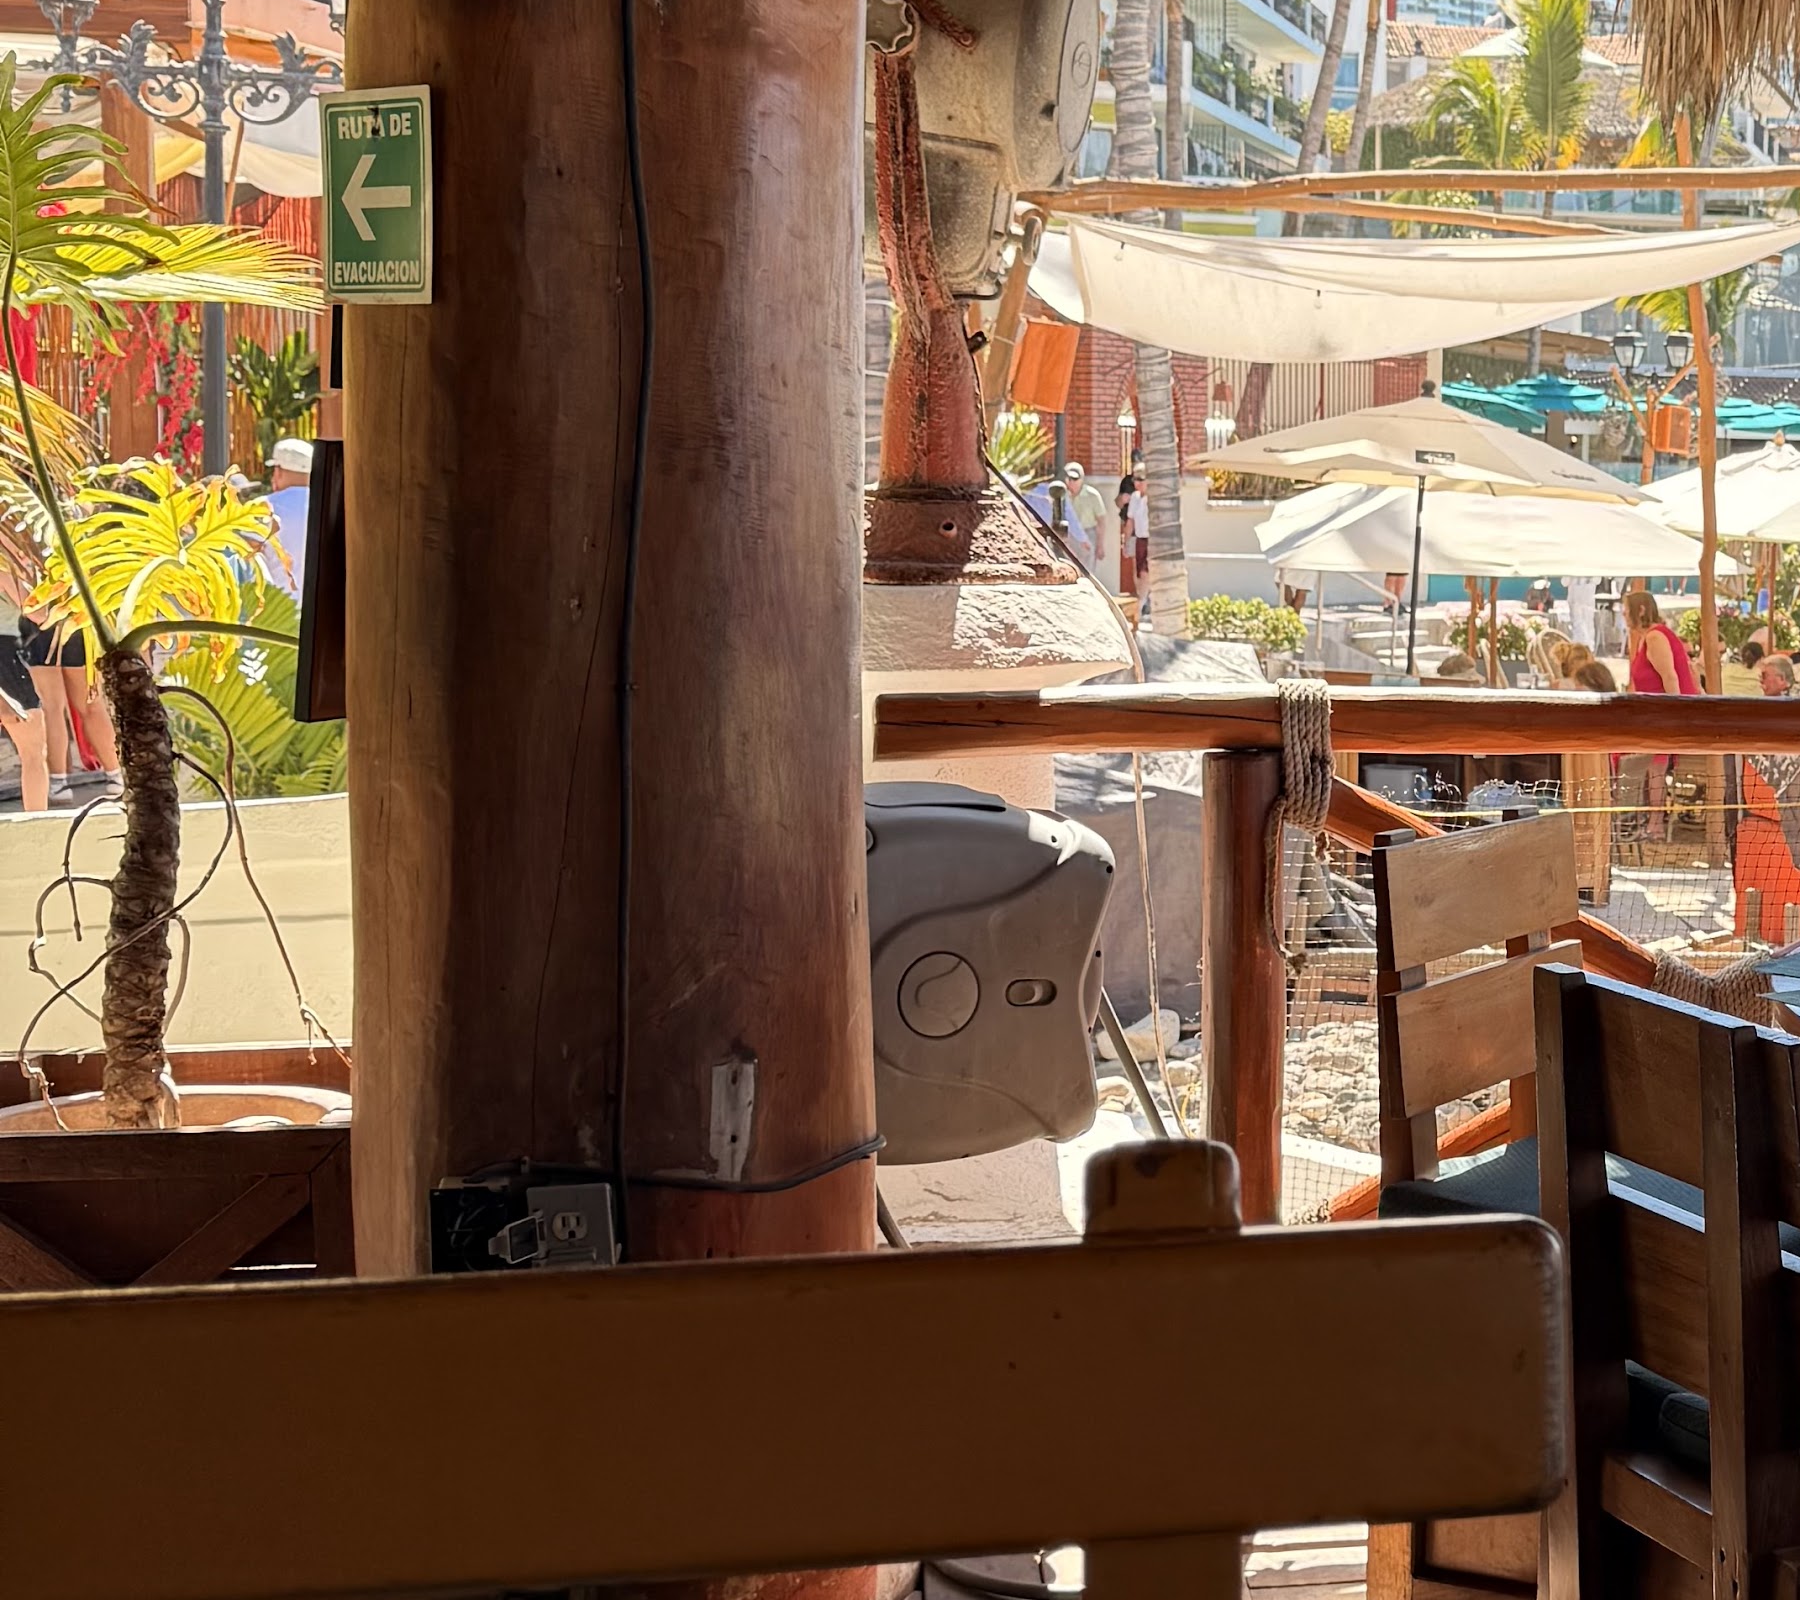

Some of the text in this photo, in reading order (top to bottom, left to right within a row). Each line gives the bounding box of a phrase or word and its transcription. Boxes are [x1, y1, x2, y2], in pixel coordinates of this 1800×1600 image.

[337, 112, 412, 140] RUTA DE
[334, 260, 419, 285] EVACUACION
